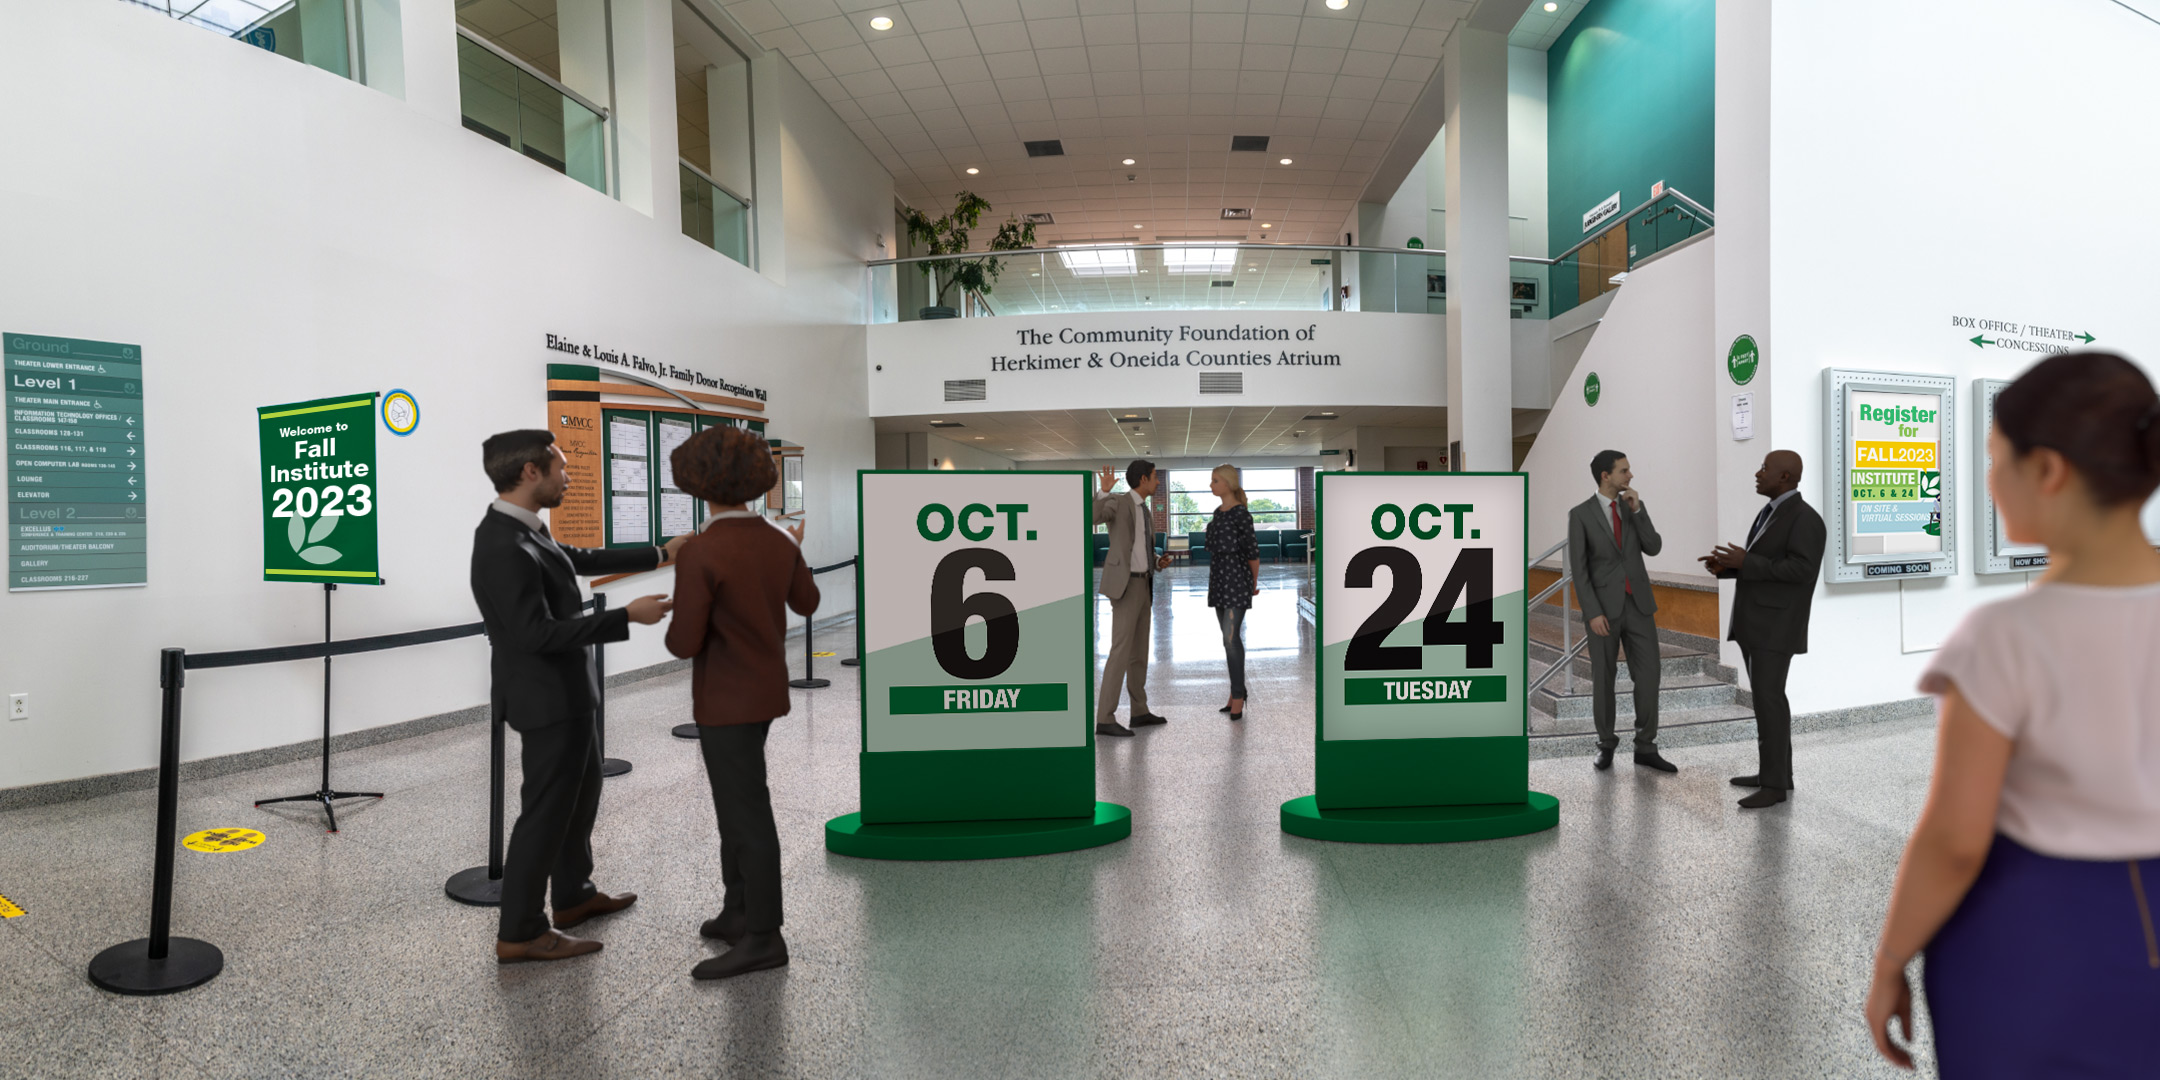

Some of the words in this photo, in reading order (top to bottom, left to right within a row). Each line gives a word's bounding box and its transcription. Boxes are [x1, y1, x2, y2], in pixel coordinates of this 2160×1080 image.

[1016, 329, 1053, 345] The
[1059, 327, 1173, 345] Community
[1179, 325, 1289, 342] Foundation
[1295, 324, 1316, 341] of
[1952, 315, 1975, 328] BOX
[1979, 319, 2018, 333] OFFICE
[2020, 324, 2025, 337] /
[2029, 325, 2074, 341] THEATER
[12, 337, 69, 353] Ground
[1996, 337, 2069, 355] CONCESSIONS
[14, 360, 41, 368] THEATER
[43, 361, 63, 369] LOWER
[65, 363, 95, 371] ENTRANCE
[546, 333, 580, 355] Elaine
[582, 344, 591, 357] &
[594, 345, 618, 364] Louis
[621, 352, 630, 367] A.
[633, 355, 657, 376] Falvo,
[658, 362, 667, 378] Jr.
[670, 365, 694, 386] Family
[696, 372, 718, 389] Donor
[719, 378, 754, 398] Recognition
[755, 388, 767, 402] Wall
[991, 354, 1081, 372] Herkimer
[1088, 352, 1103, 368] &
[1110, 350, 1180, 368] Oneida
[1186, 350, 1272, 366] Counties
[1276, 350, 1341, 366] Atrium
[14, 375, 61, 389] Level
[68, 379, 76, 390] 1
[14, 396, 41, 404] THEATER
[60, 399, 90, 407] ENTRANCE
[14, 409, 55, 417] INFORMATION
[56, 411, 93, 420] TECHNOLOGY
[95, 413, 117, 421] OFFICES
[14, 415, 56, 423] CLASSROOMS
[569, 416, 593, 428] MVCC
[1860, 404, 1937, 425] Register
[15, 428, 58, 436] CLASSROOMS
[279, 425, 332, 438] Welcome
[336, 422, 348, 432] to
[1898, 424, 1919, 437] for
[15, 443, 58, 451] CLASSROOMS
[295, 437, 336, 459] Fall
[270, 460, 369, 483] Institute
[1852, 472, 1915, 485] INSTITUTE
[272, 484, 372, 518] 2023
[1853, 489, 1876, 498] OCT.
[1880, 489, 1885, 497] 6
[1891, 489, 1897, 497] &
[1902, 489, 1913, 497] 24
[20, 507, 60, 519] Level
[66, 507, 76, 519] 2
[1861, 504, 1872, 512] ON
[1873, 504, 1891, 512] SITE
[1892, 504, 1898, 512] &
[917, 503, 1037, 541] OCT.
[1371, 503, 1481, 540] OCT.
[1861, 514, 1894, 522] VIRTUAL
[1895, 512, 1931, 521] SESSIONS
[21, 543, 87, 551] AUDITORIUM/THEATER
[1868, 565, 1902, 575] COMING
[1906, 564, 1930, 572] SOON
[2015, 558, 2031, 566] NOW
[931, 547, 1019, 680] 6
[1344, 546, 1504, 671] 24
[1383, 680, 1472, 700] TUESDAY
[943, 688, 1021, 710] FRIDAY
